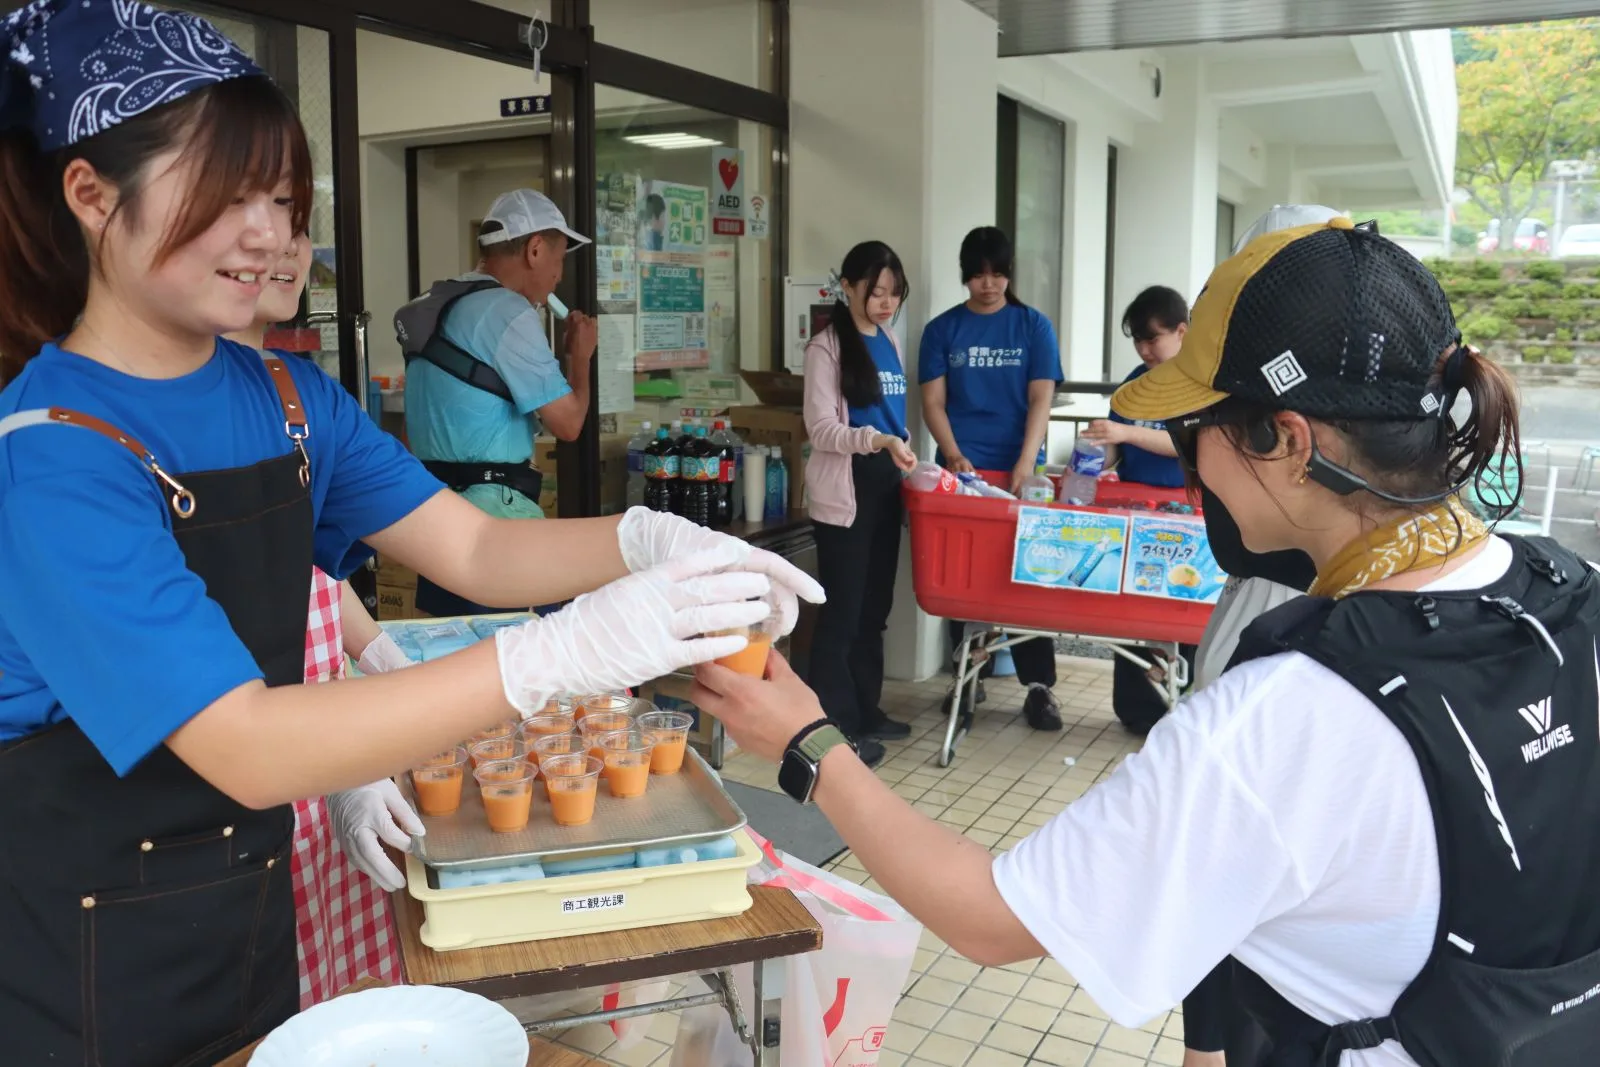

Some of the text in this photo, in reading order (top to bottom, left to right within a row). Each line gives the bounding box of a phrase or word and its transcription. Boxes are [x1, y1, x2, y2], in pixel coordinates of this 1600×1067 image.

[507, 97, 545, 114] 事務室
[718, 193, 740, 208] AED
[968, 356, 1003, 367] 2026
[882, 383, 905, 395] 2026
[1520, 723, 1574, 764] WELLWISE
[563, 894, 624, 911] 商工観光課
[1550, 1001, 1564, 1016] AIR
[1564, 994, 1585, 1010] WIND
